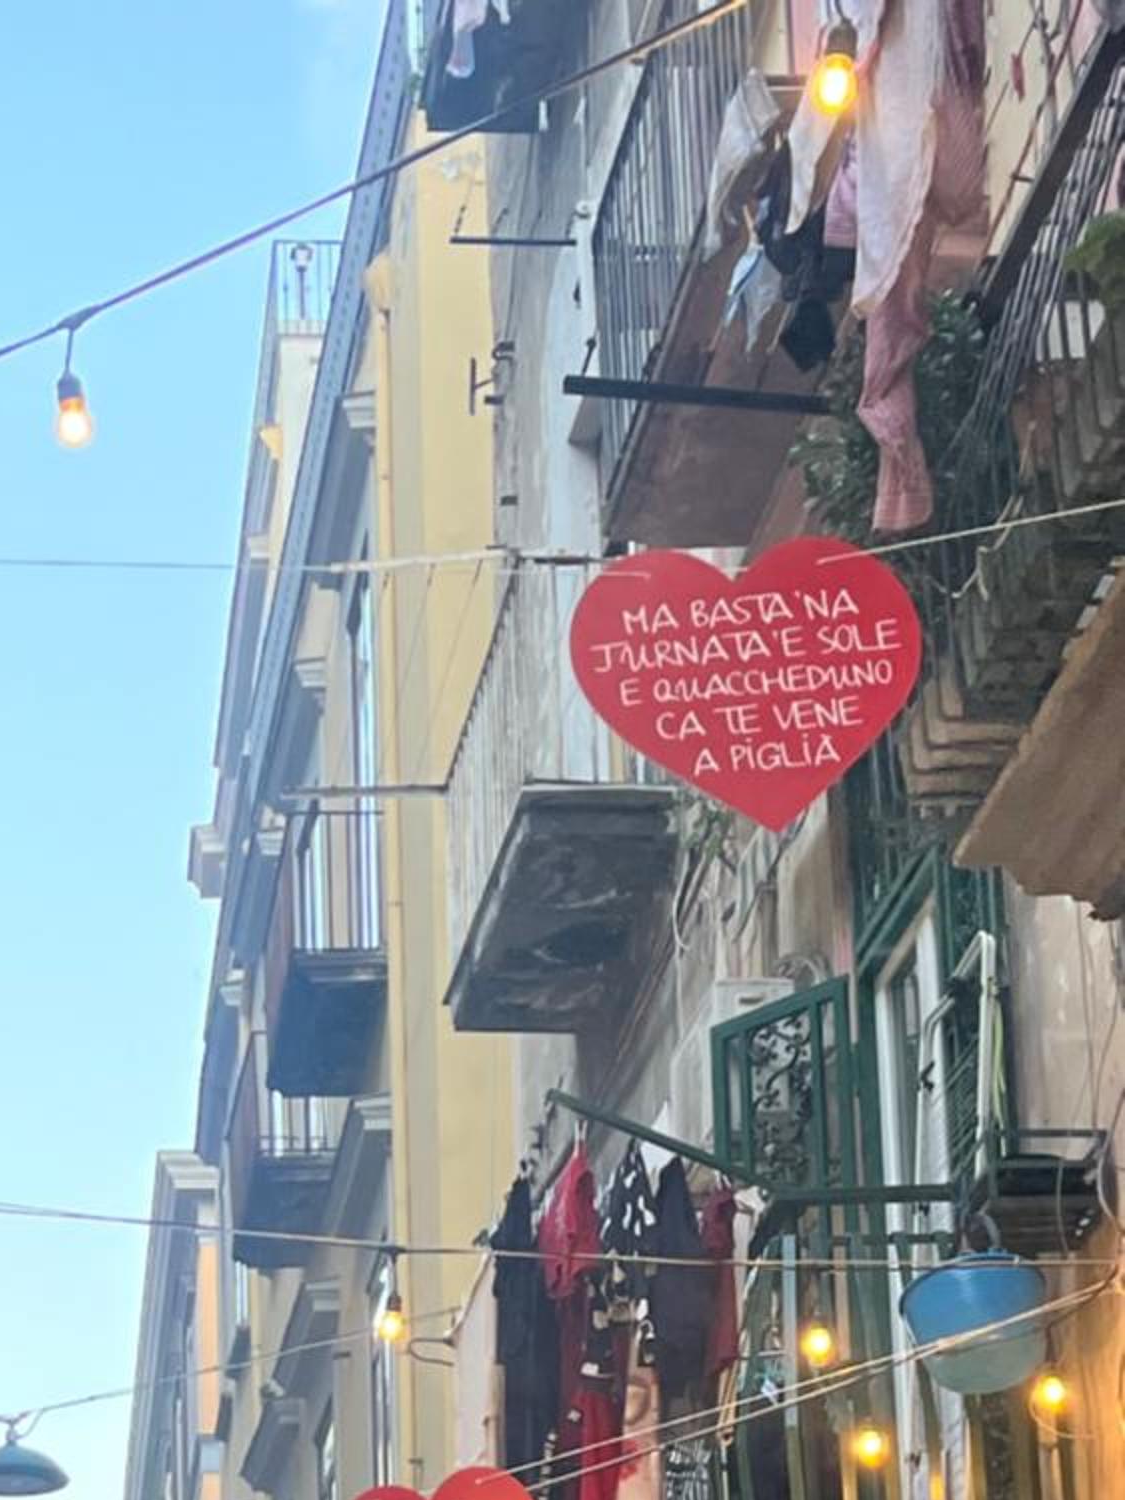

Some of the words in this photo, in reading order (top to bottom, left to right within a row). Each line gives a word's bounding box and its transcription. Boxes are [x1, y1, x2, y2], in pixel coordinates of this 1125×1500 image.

[623, 604, 678, 635] MA
[690, 591, 793, 628] BASTA
[591, 630, 770, 672] JURNATA
[817, 618, 901, 653] SOLE
[620, 678, 641, 707] E
[653, 659, 892, 703] QUACCHEDUNO
[656, 711, 707, 741] CA
[714, 704, 760, 735] TE
[773, 696, 863, 730] VENE
[694, 748, 719, 776] A
